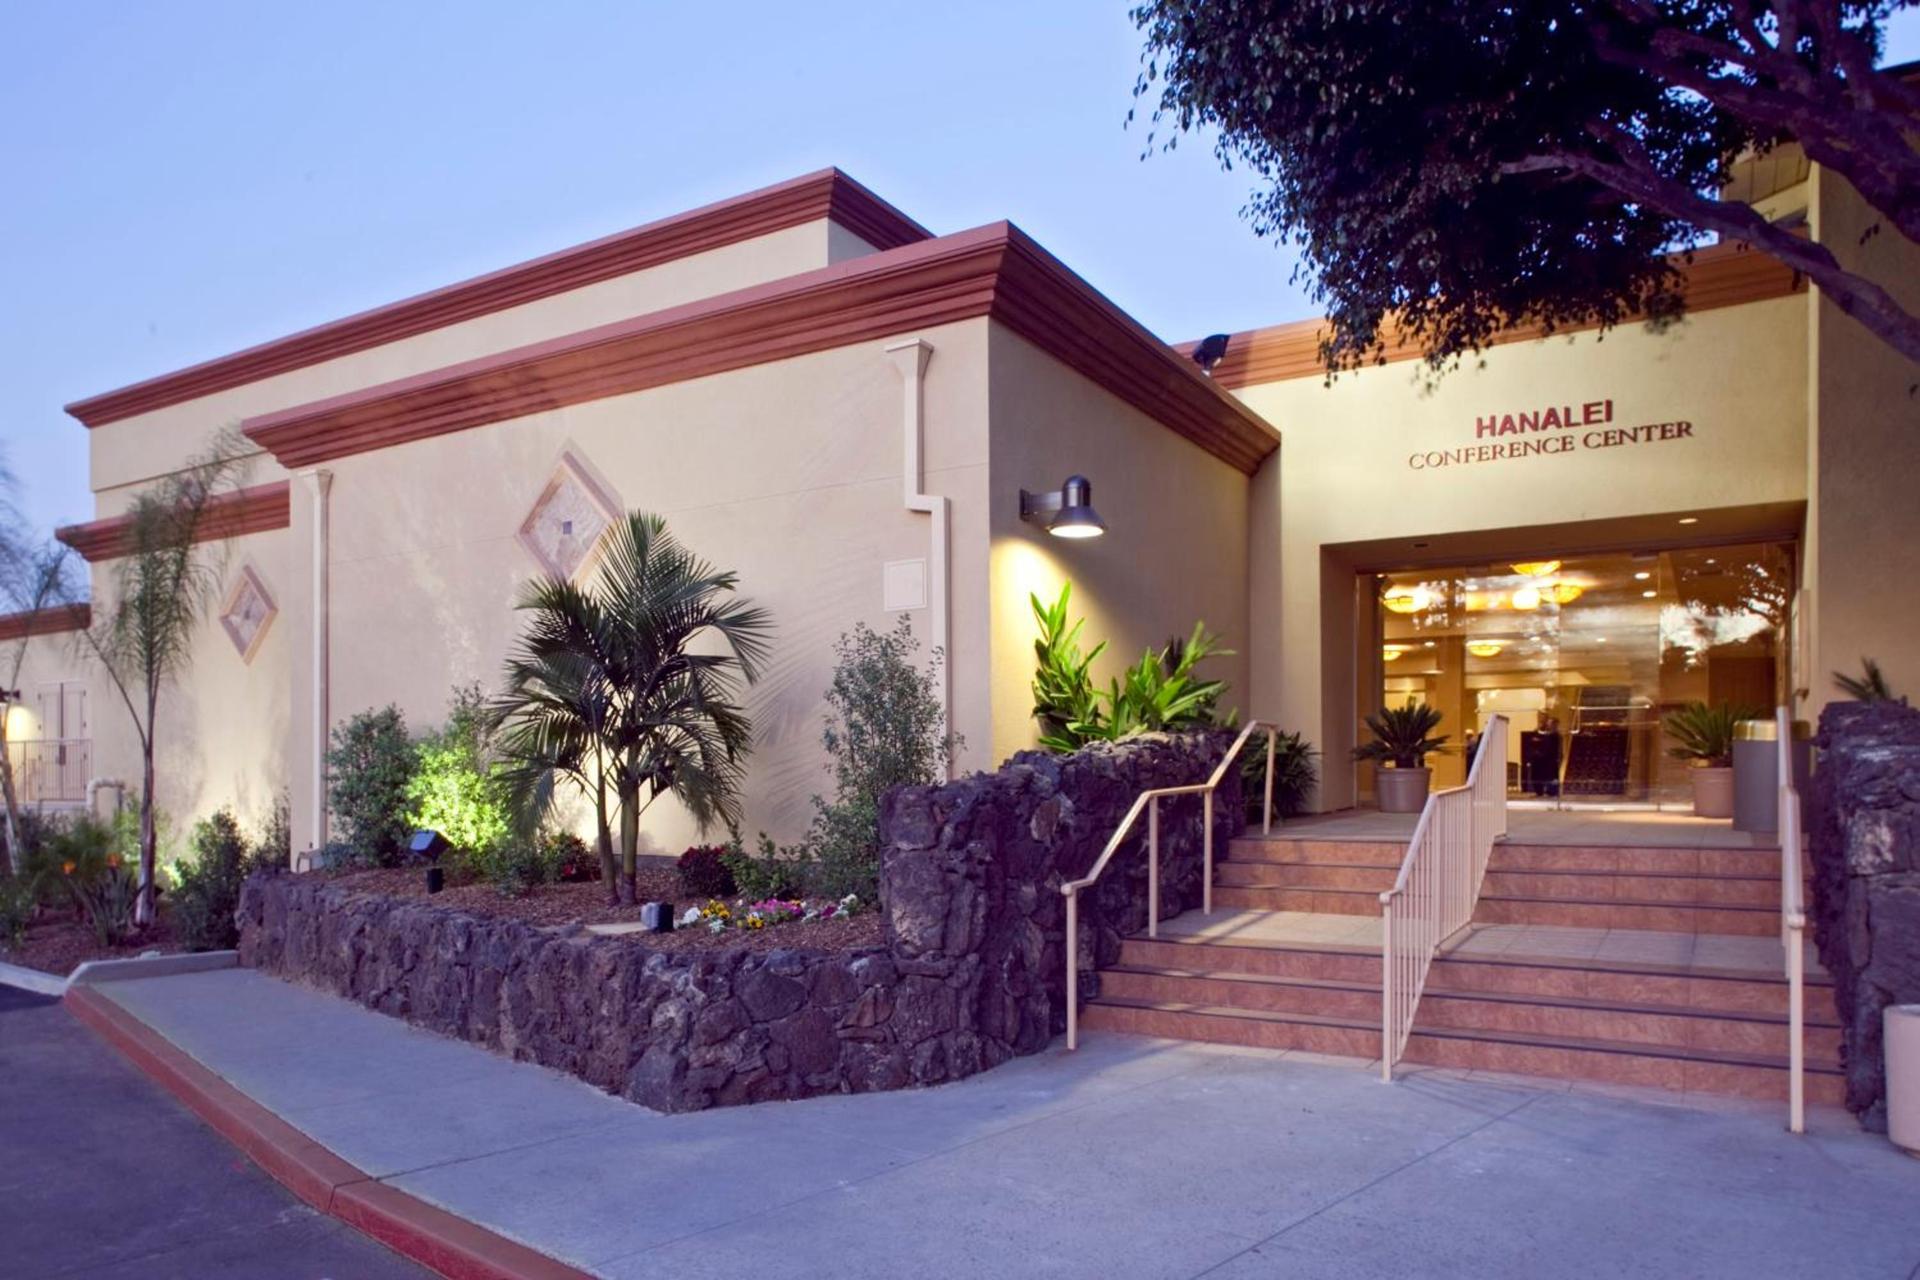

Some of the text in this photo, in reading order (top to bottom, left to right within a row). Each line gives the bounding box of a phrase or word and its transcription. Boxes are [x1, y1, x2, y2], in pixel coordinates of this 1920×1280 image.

[1476, 399, 1614, 438] HANALEI
[1409, 420, 1694, 469] CONFERENCE CENTER
